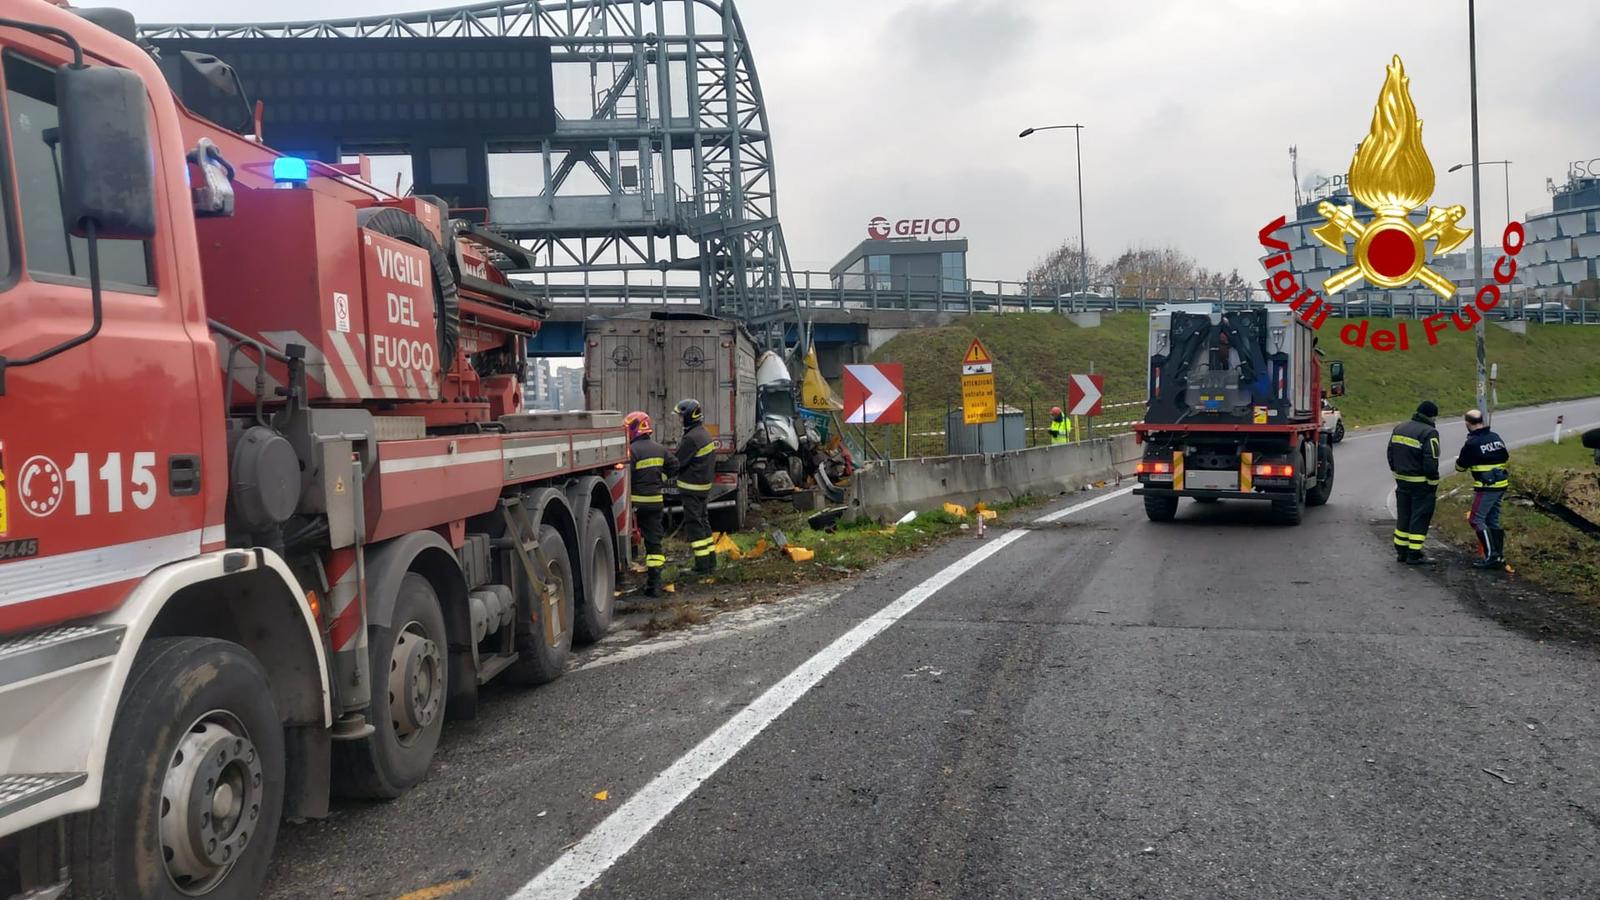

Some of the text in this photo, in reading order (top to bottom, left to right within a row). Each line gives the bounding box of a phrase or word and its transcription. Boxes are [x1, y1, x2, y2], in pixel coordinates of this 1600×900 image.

[895, 217, 961, 236] GEICO
[376, 245, 424, 288] VIGILI
[387, 292, 420, 328] DEL
[373, 334, 434, 371] FUOCO
[65, 451, 158, 516] 115
